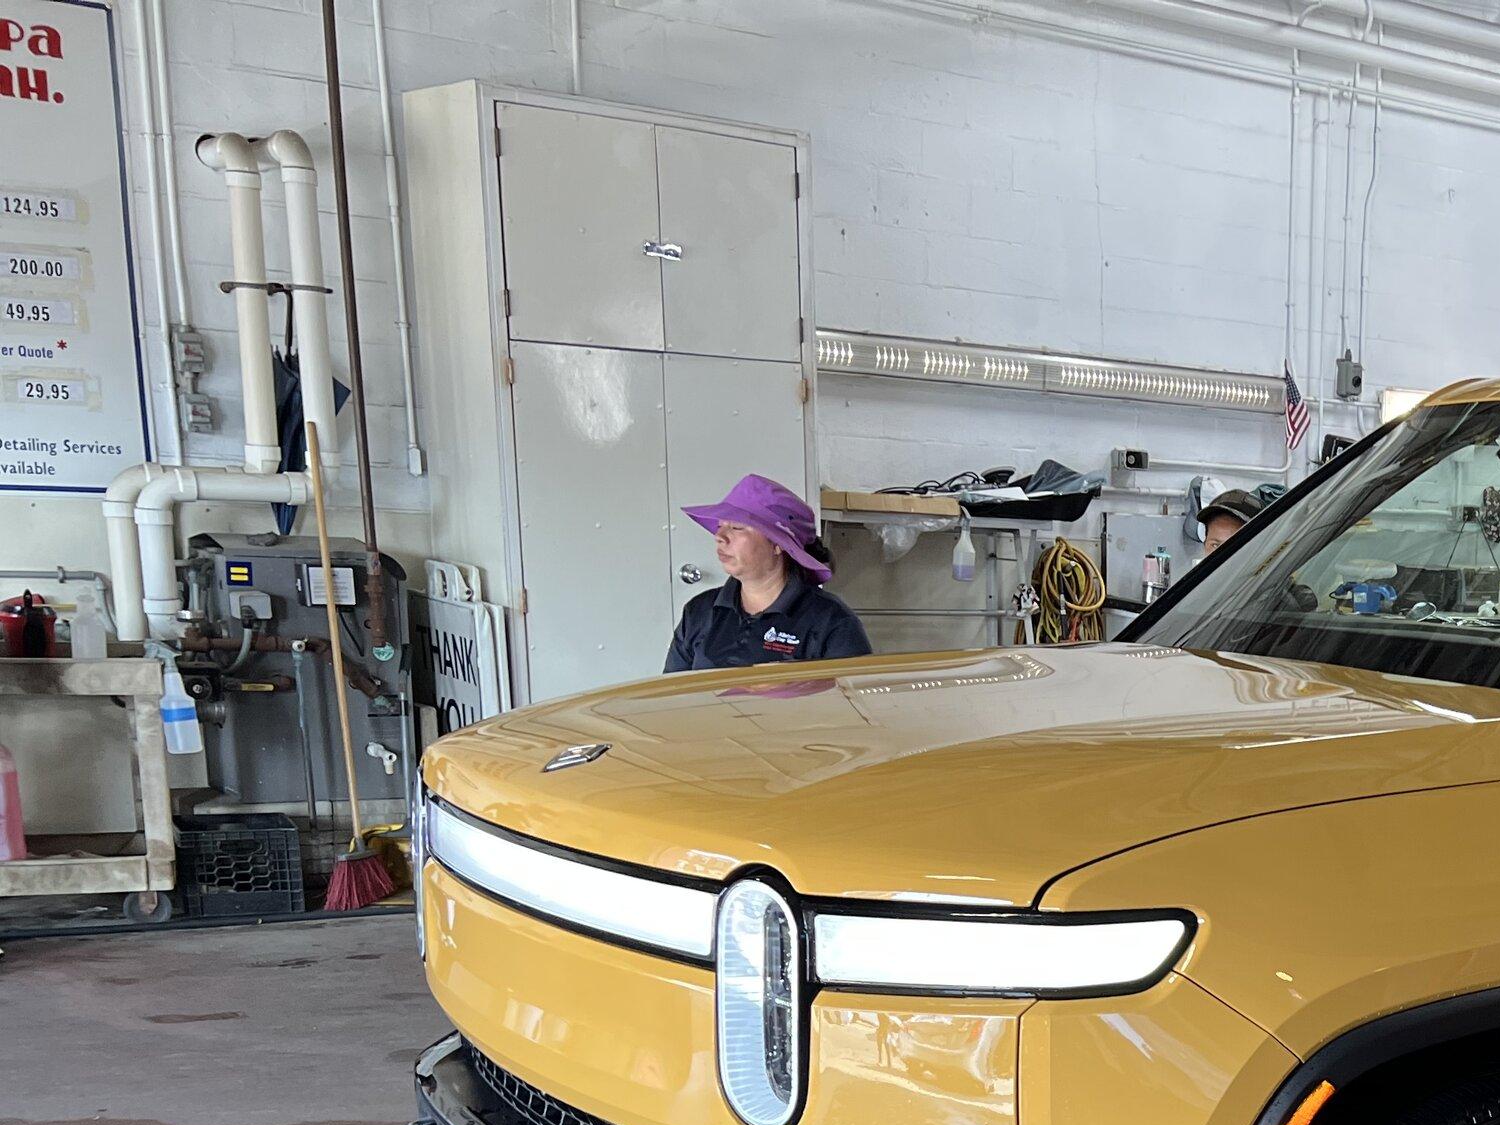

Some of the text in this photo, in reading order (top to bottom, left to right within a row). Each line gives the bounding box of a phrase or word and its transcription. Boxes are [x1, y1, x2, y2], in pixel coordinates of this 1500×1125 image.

[3, 197, 59, 217] 124.95
[10, 258, 63, 277] 200.00
[6, 303, 50, 321] 49.95
[18, 345, 53, 359] Quote
[25, 382, 69, 400] 29.95
[63, 439, 122, 455] Services
[0, 461, 55, 475] vailable
[416, 624, 477, 687] THANK
